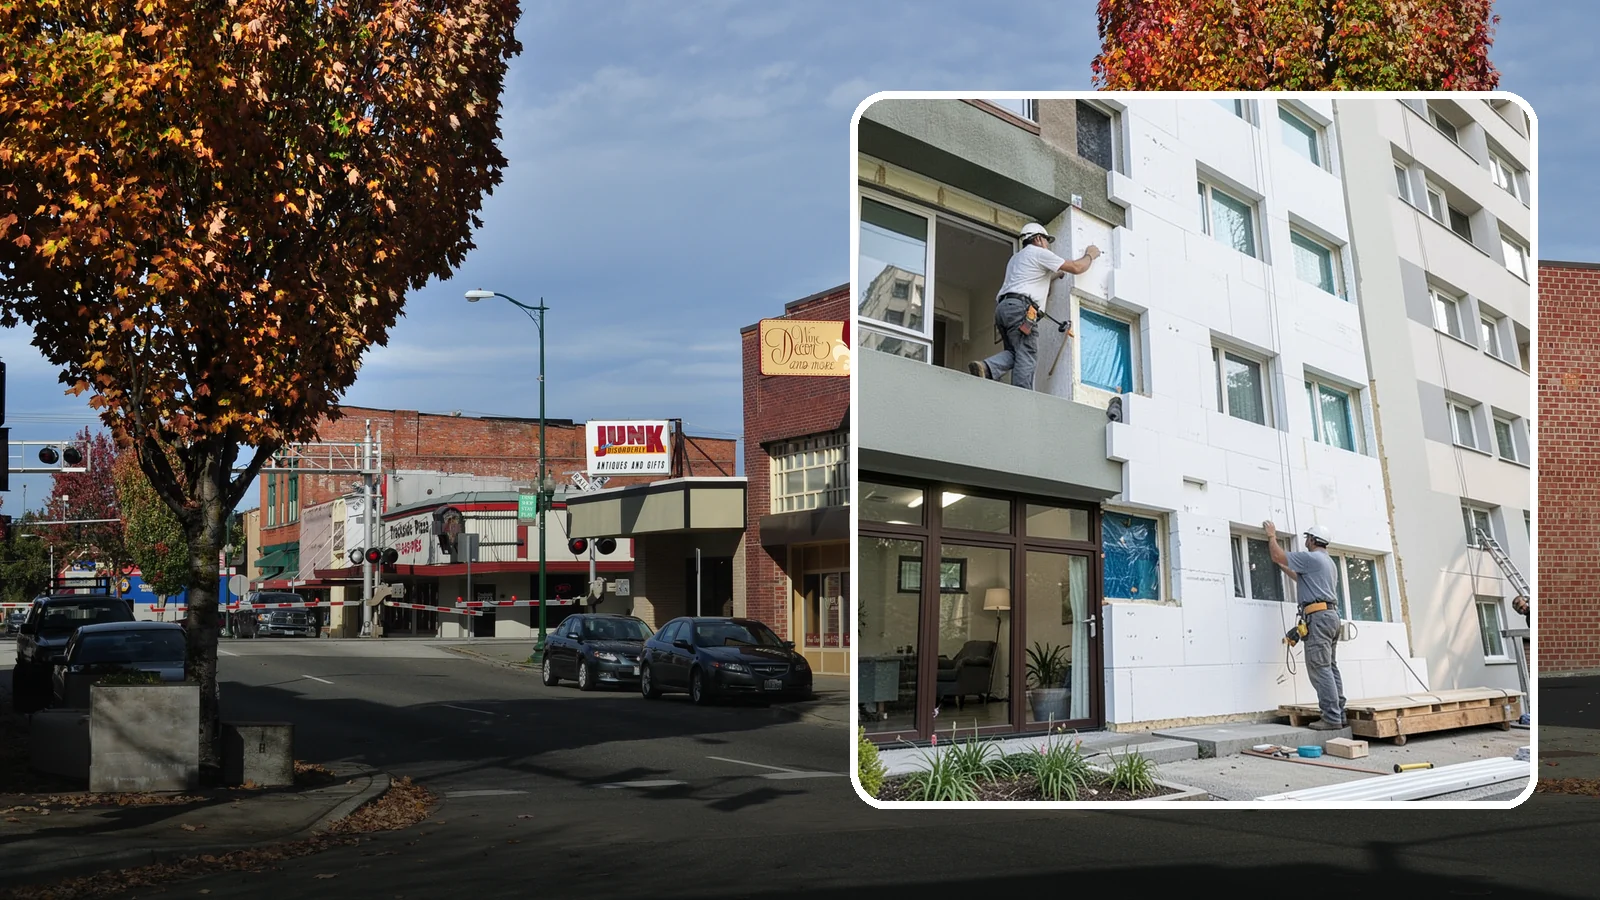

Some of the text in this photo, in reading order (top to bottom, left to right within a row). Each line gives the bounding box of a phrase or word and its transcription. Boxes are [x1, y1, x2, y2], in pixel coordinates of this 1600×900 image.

[765, 328, 830, 365] Decor
[596, 425, 665, 457] JUNK
[607, 446, 645, 454] DISORDERLY
[597, 460, 665, 470] ANTIQUES AND GIFTS
[415, 519, 429, 534] Pizza
